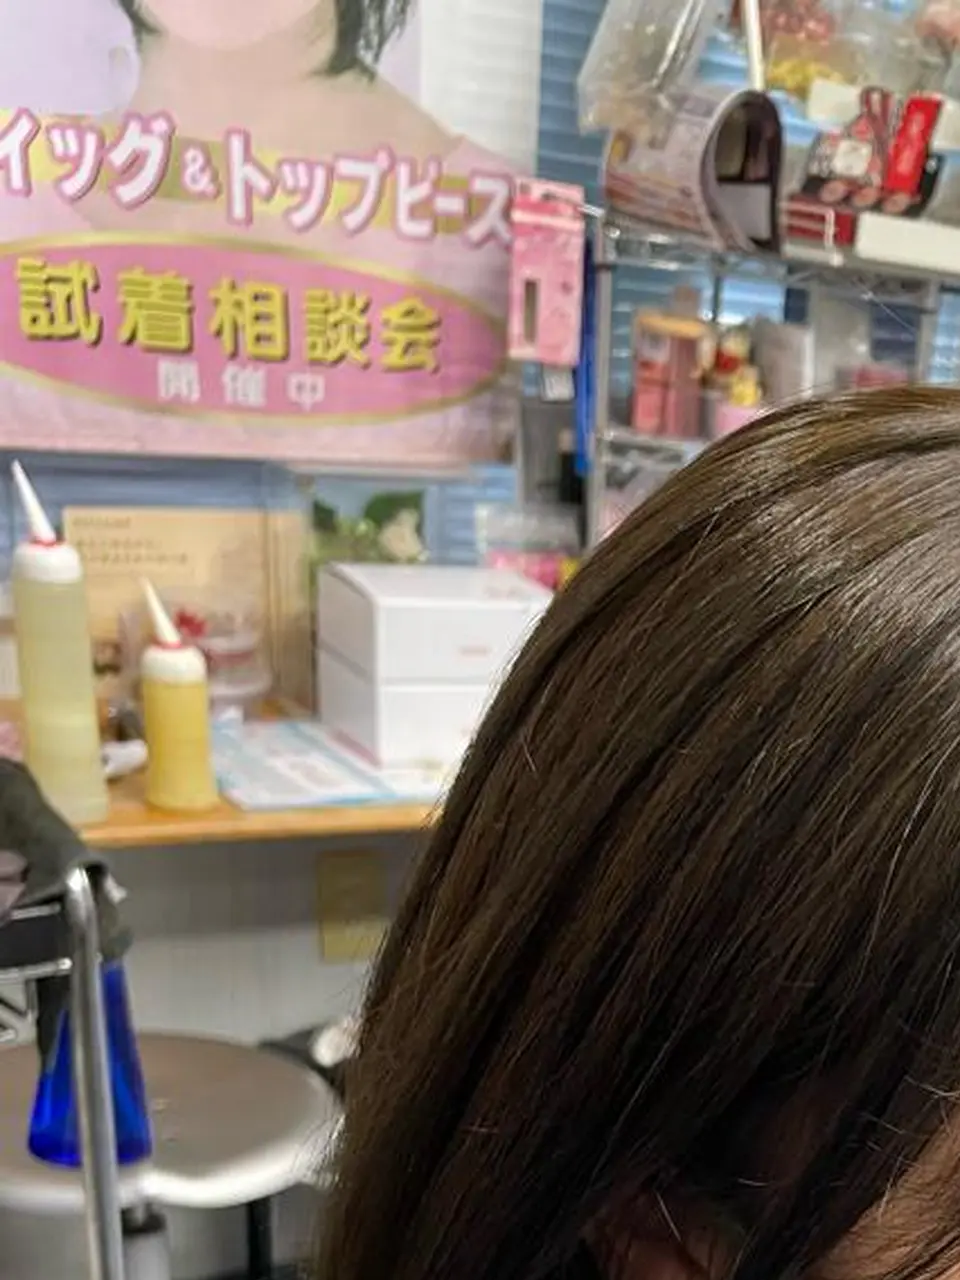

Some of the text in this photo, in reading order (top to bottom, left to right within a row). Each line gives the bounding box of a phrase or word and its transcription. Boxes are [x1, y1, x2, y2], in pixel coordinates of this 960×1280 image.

[16, 256, 442, 372] 試着相談会
[157, 359, 326, 412] 開催中
